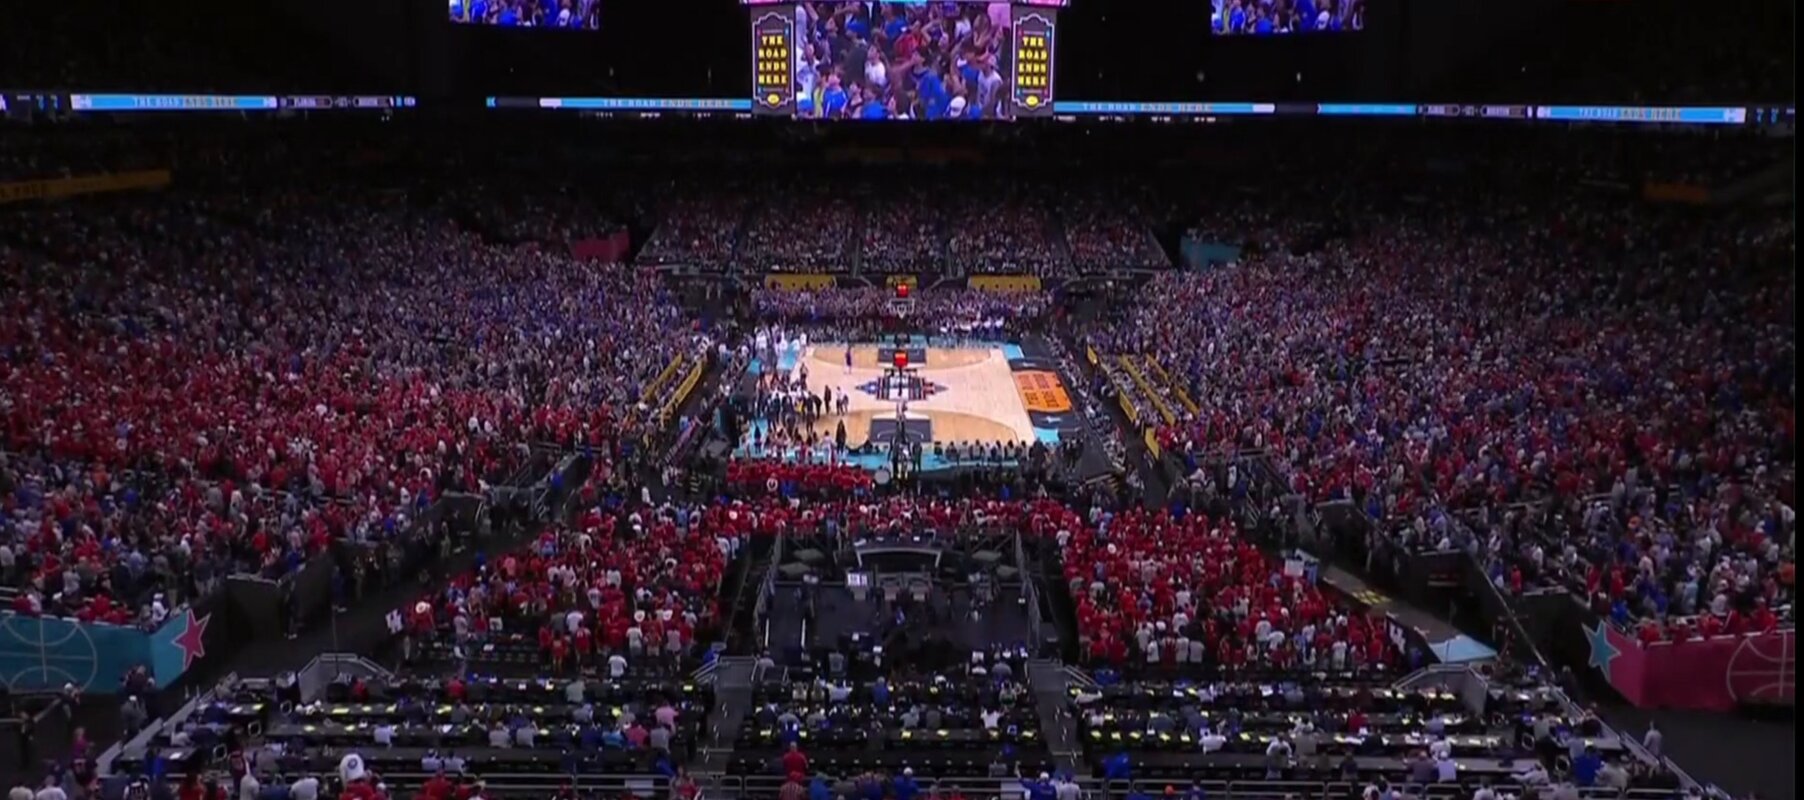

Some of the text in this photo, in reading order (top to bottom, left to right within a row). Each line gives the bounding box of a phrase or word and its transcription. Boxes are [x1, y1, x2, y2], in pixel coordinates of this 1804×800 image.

[762, 36, 783, 45] THE
[1022, 36, 1044, 47] THE
[759, 48, 787, 58] ROAD
[1018, 49, 1047, 59] ROAD
[759, 61, 787, 71] ENDS
[1018, 63, 1047, 73] ENDS
[759, 74, 787, 84] HERE
[1018, 76, 1047, 86] HERE
[603, 99, 622, 107] THE
[628, 99, 656, 107] ROAD
[1082, 102, 1101, 111] THE
[1108, 102, 1137, 111] ROAD
